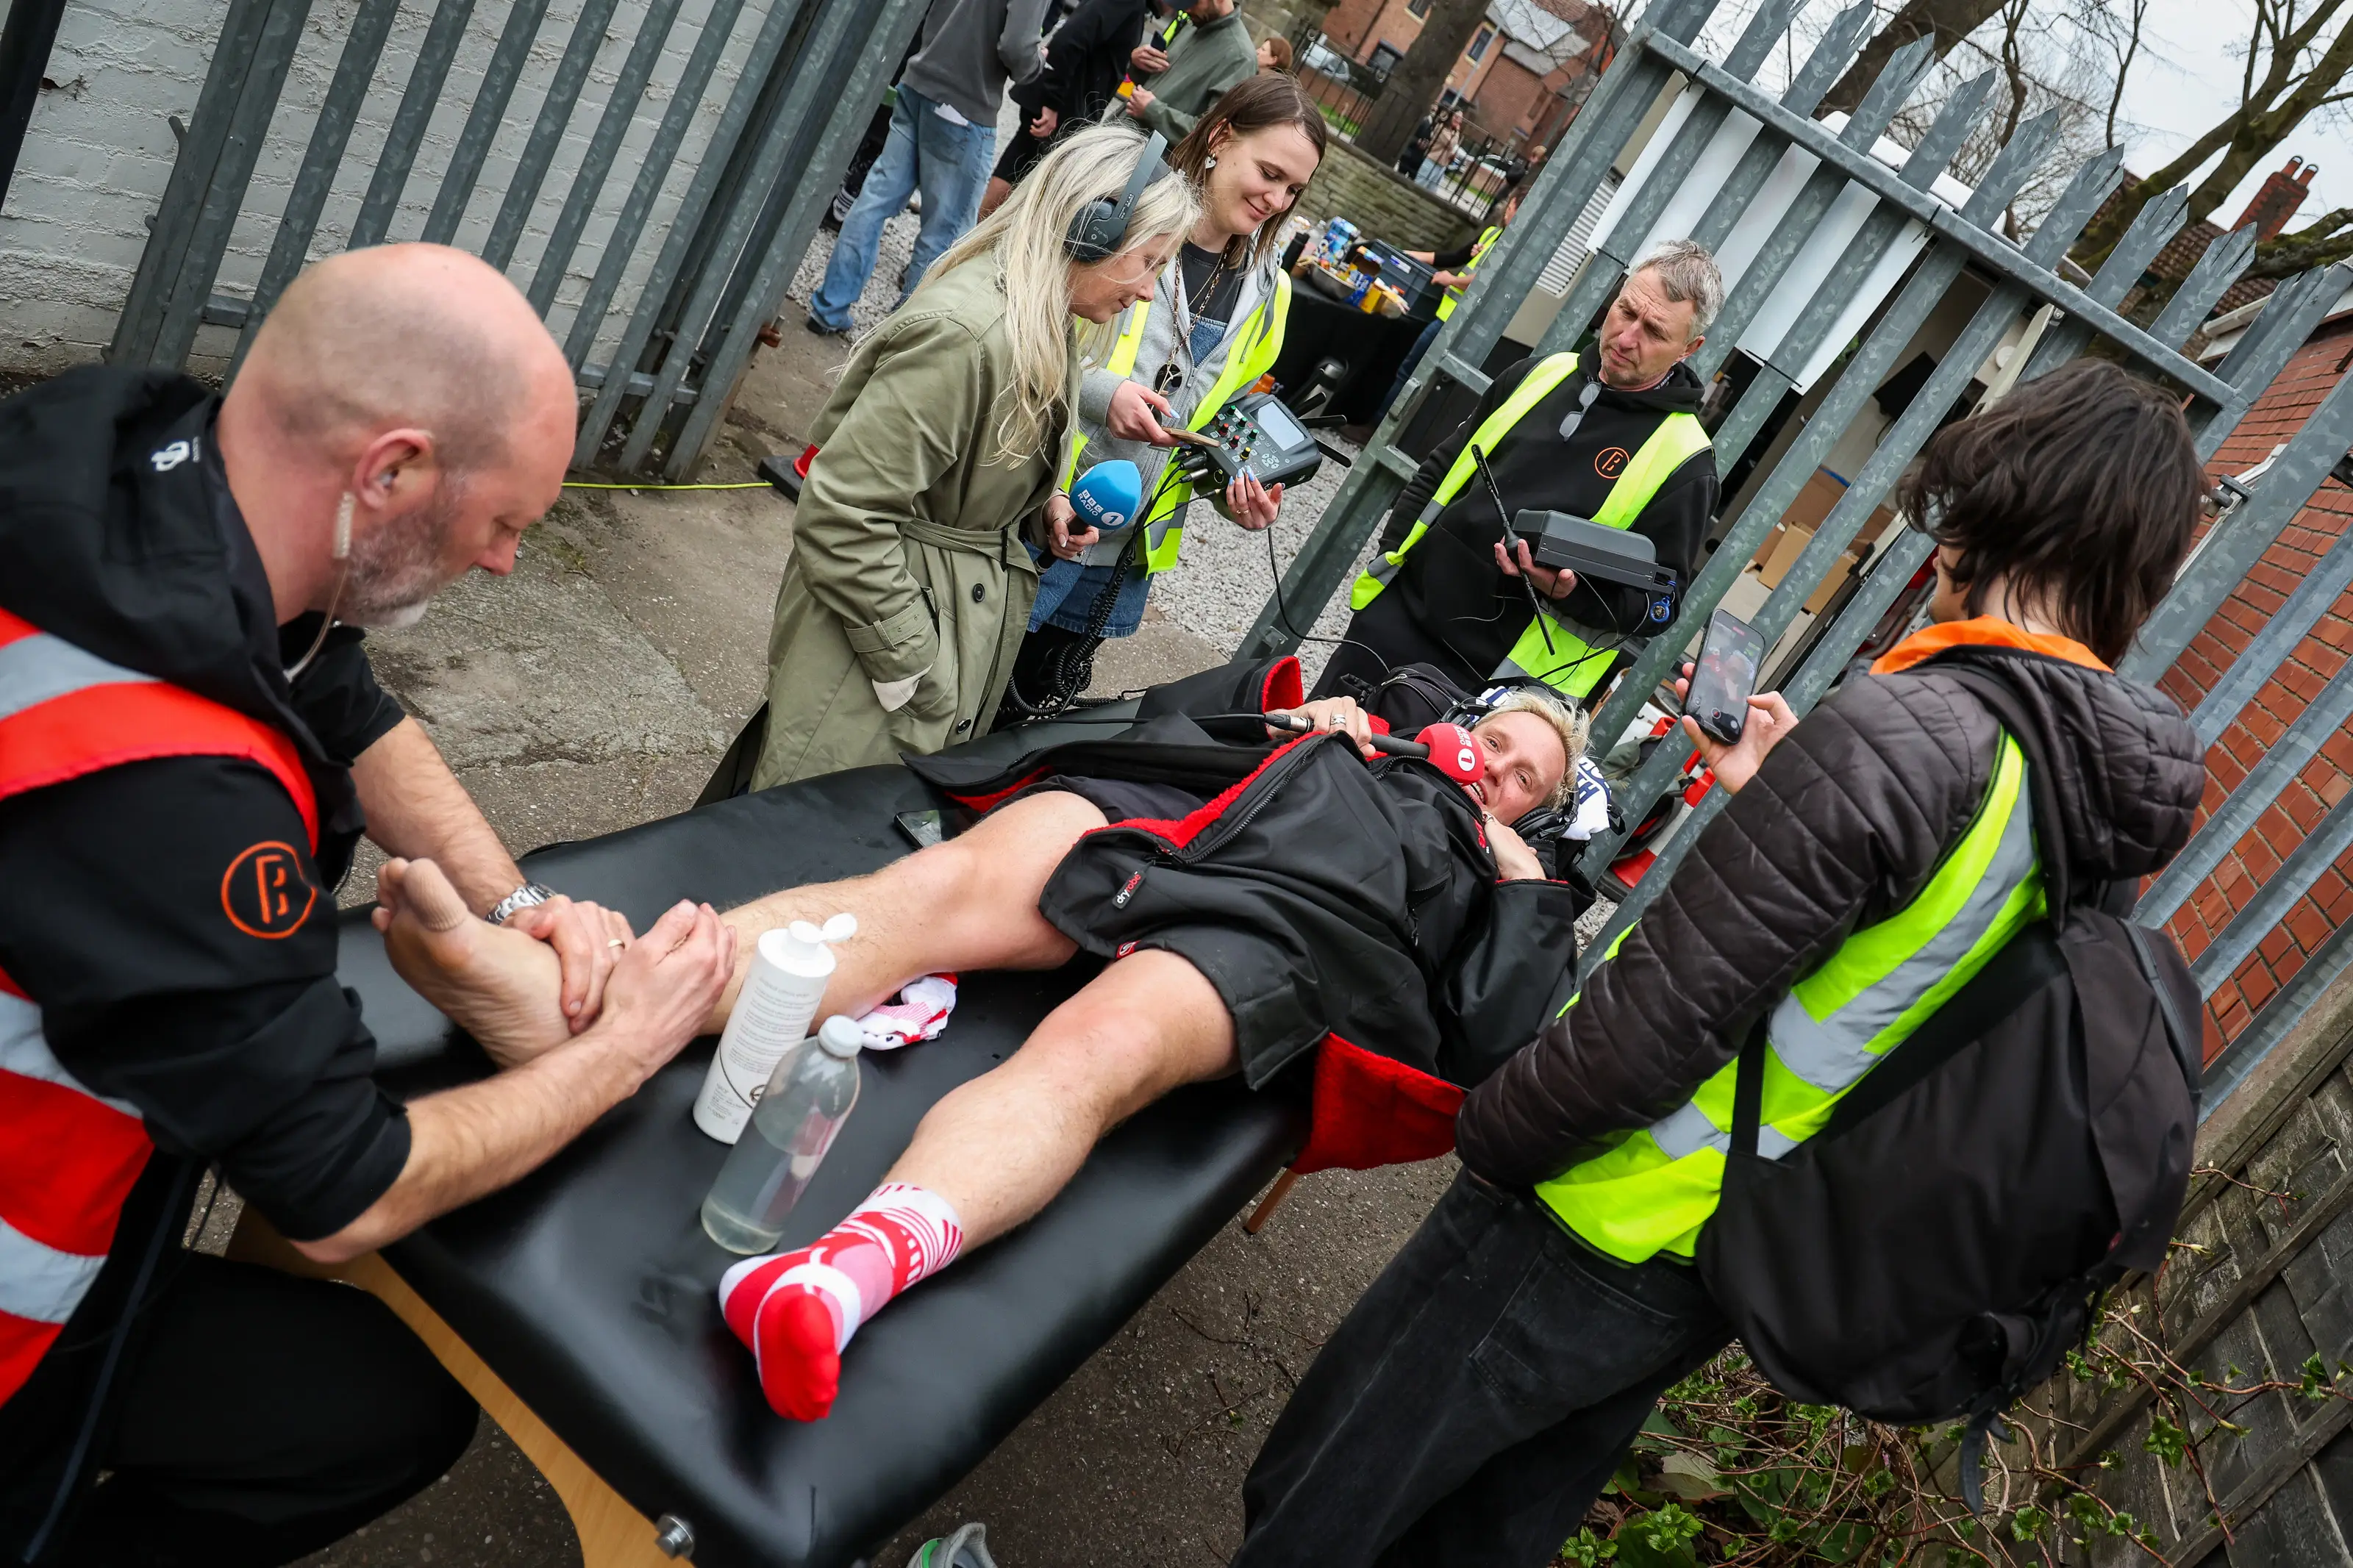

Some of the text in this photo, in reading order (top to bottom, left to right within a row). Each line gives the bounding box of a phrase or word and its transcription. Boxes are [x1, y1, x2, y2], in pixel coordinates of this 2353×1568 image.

[1077, 493, 1099, 516] RADIO
[1082, 489, 1104, 513] BBC
[1116, 873, 1141, 904] dryrobe
